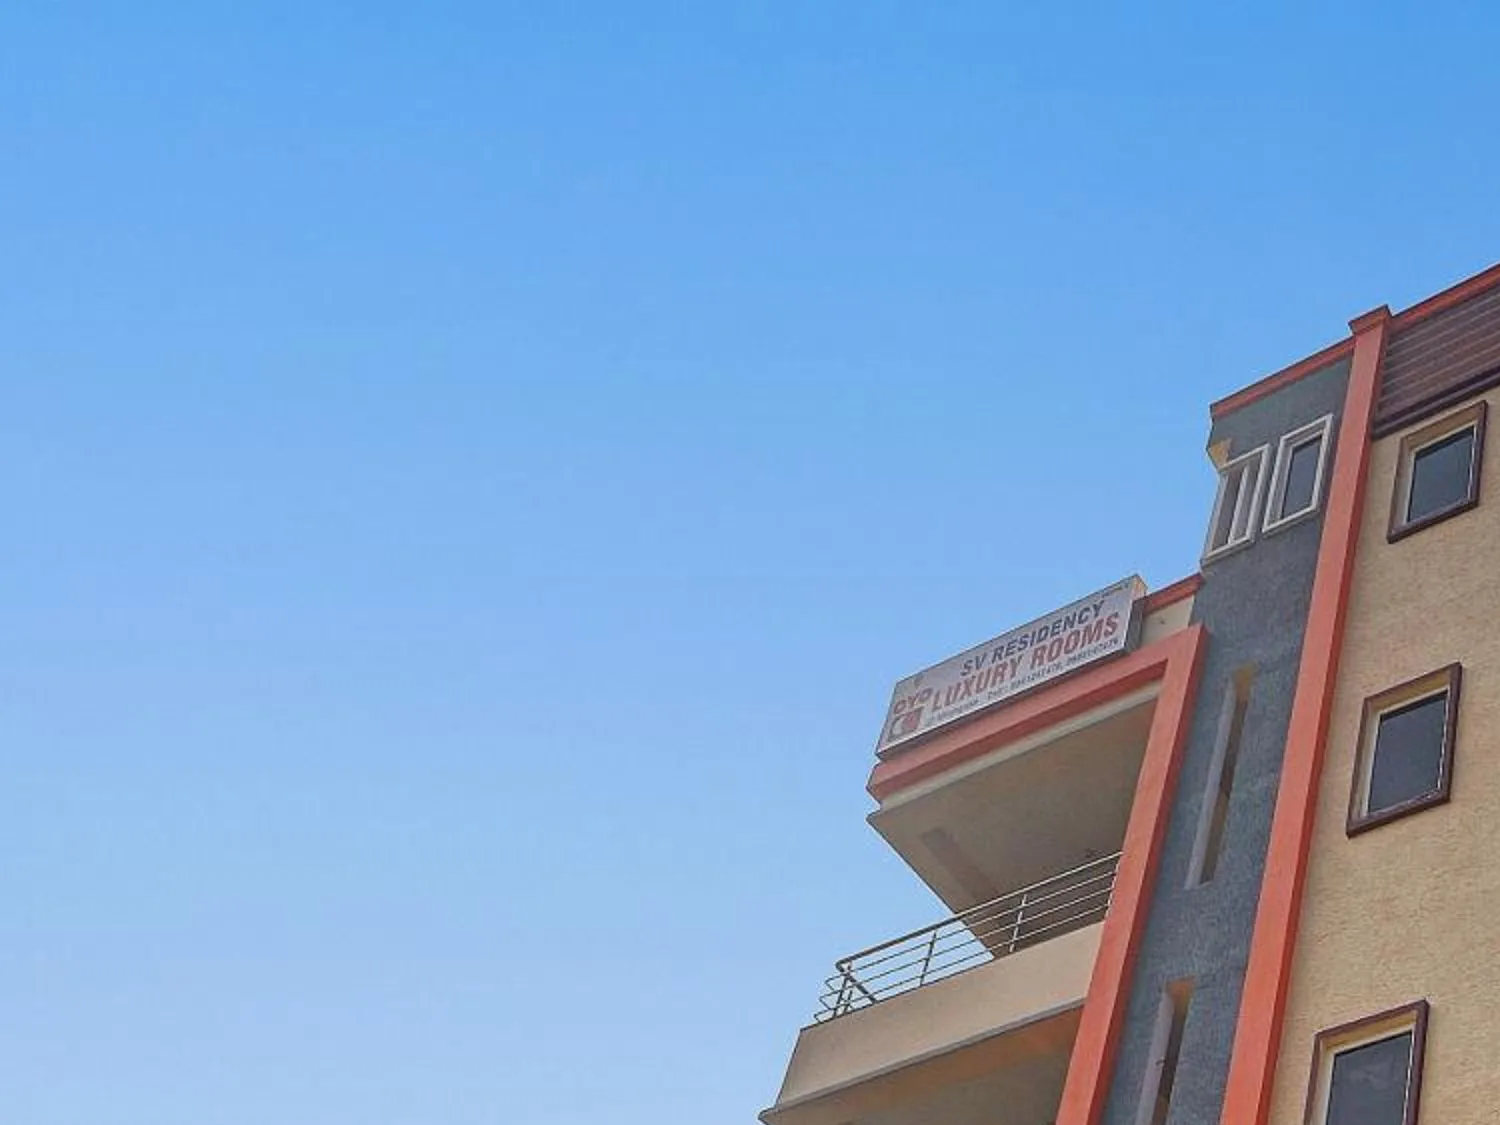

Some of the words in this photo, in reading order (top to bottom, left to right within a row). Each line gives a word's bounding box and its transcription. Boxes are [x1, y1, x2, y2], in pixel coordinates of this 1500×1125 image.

[932, 654, 1024, 712] LUXURY
[1030, 612, 1119, 669] ROOMS
[960, 652, 988, 676] SV
[992, 600, 1105, 664] RESIDENCY
[893, 687, 934, 715] OYO
